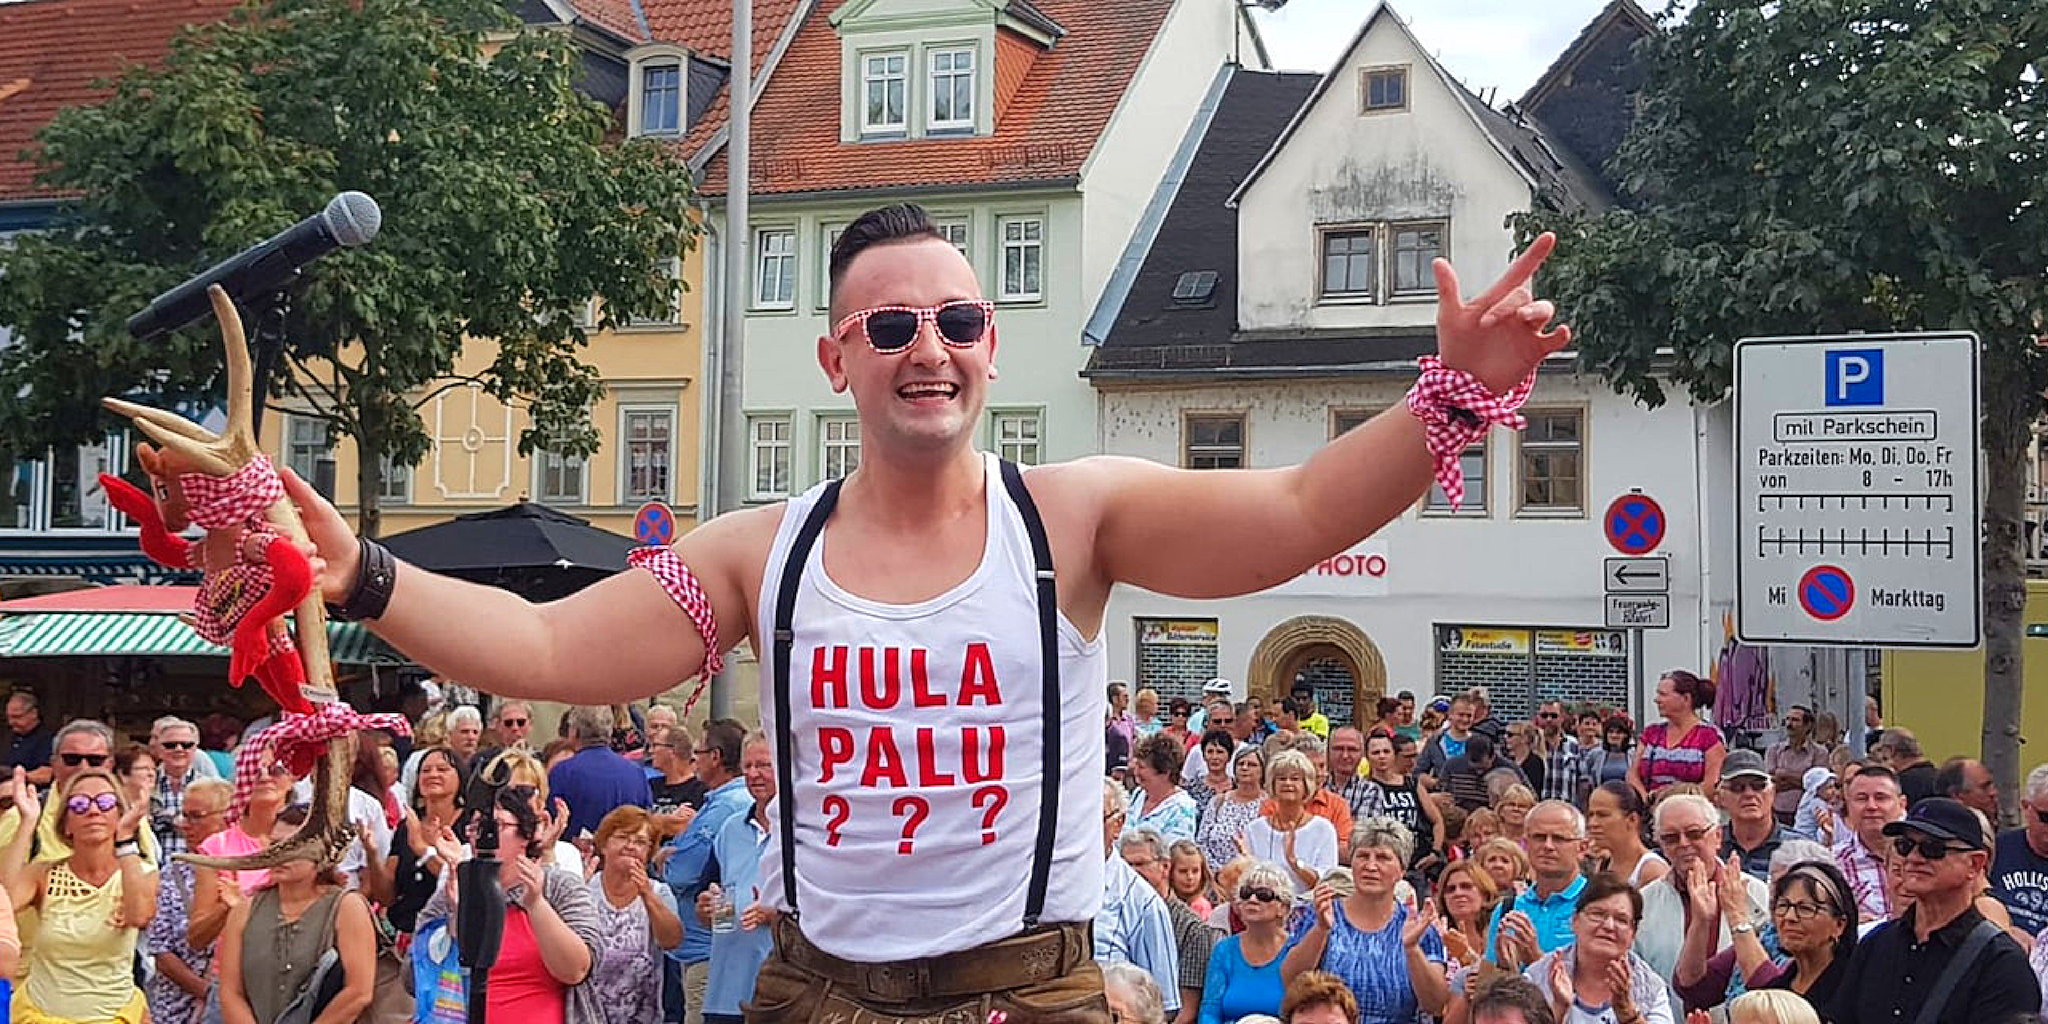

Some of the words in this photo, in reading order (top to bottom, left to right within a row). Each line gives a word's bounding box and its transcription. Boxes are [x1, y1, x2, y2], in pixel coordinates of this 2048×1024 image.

[1838, 356, 1870, 400] P
[1785, 418, 1814, 436] mit
[1823, 417, 1925, 434] Parkschein
[1759, 448, 1844, 466] Parkzeiten:
[1936, 446, 1953, 464] Fr
[1760, 473, 1787, 488] von
[1862, 470, 1872, 487] 8
[1926, 469, 1953, 487] 17h
[1305, 554, 1387, 577] HOTO
[1768, 587, 1786, 604] Mi
[1871, 588, 1945, 611] Markttag
[811, 642, 1002, 710] HULA
[817, 726, 1006, 788] PALU
[821, 794, 851, 847] ?
[892, 796, 930, 855] ?
[971, 785, 1009, 846] ?
